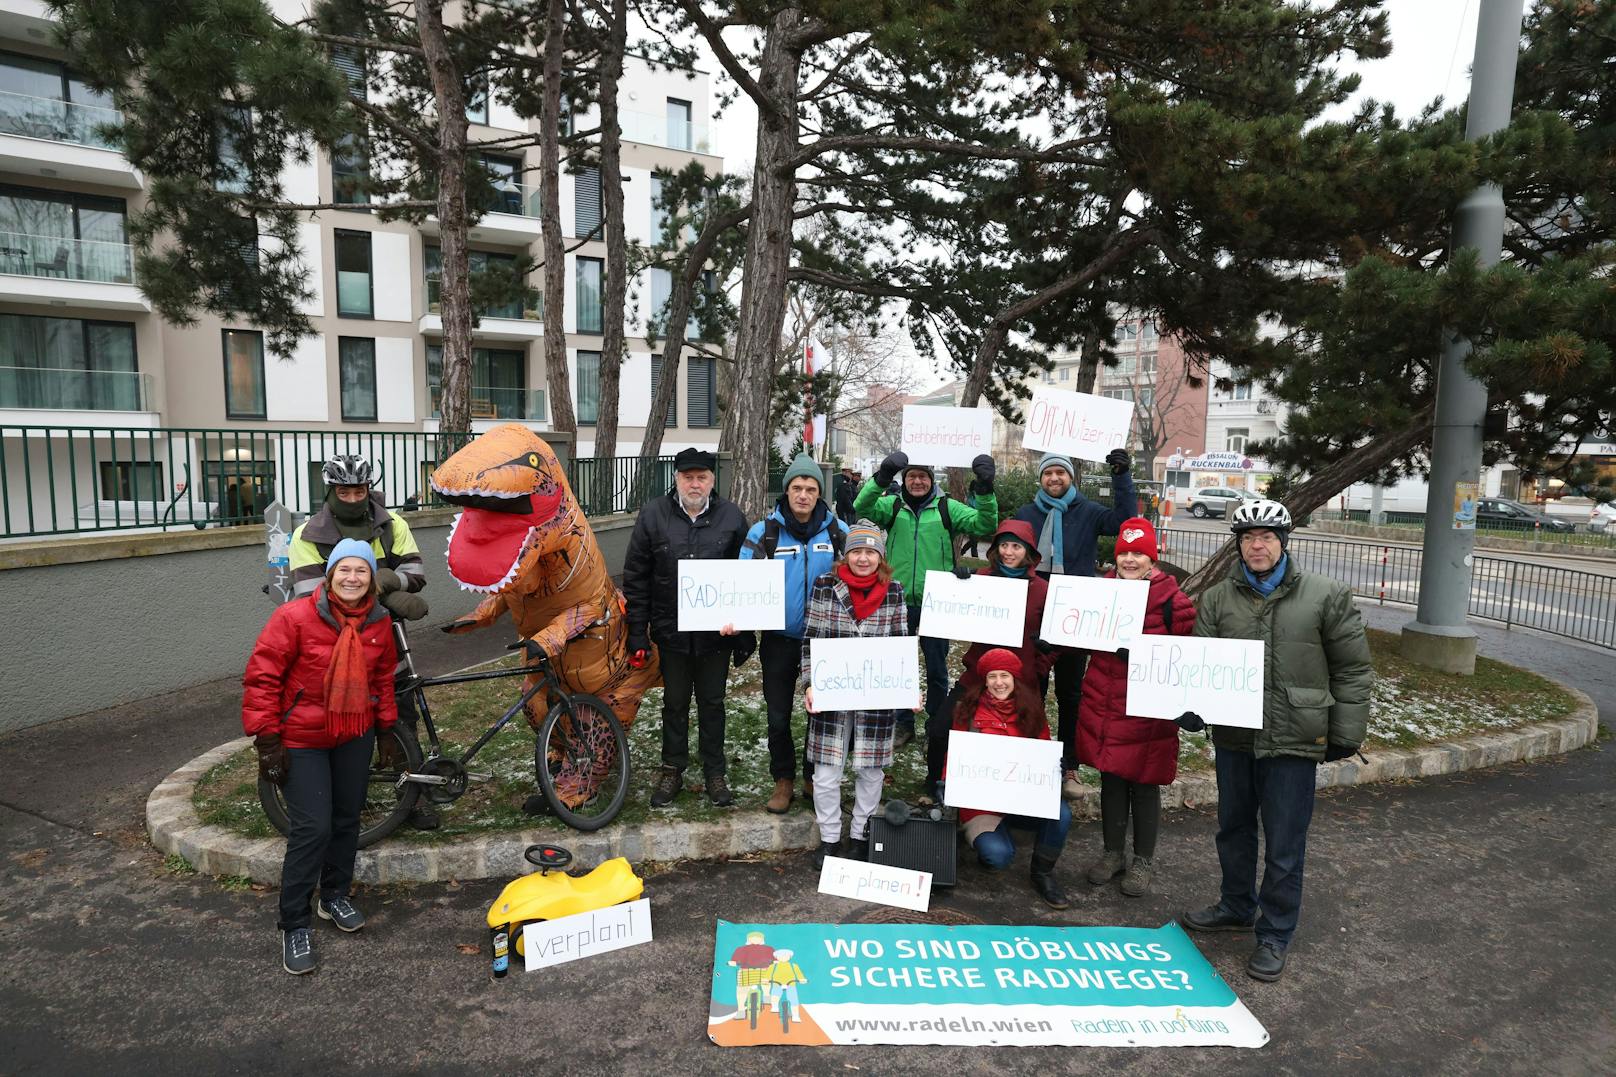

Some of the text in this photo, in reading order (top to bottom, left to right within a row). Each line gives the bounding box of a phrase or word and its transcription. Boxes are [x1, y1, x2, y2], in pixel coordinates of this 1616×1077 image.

[903, 423, 981, 448] Gehbehinderte
[1600, 445, 1616, 453] PA
[1190, 460, 1254, 469] RUCKENBAUR
[1048, 585, 1135, 642] Familie
[813, 656, 913, 697] Geschäftsleute
[535, 905, 633, 958] verplant
[823, 936, 1172, 962] WO SIND DÖBLINGS
[830, 966, 1194, 991] SICHERE RADWEGE?
[835, 1016, 1053, 1034] www.radeln.wien
[1070, 1018, 1133, 1034] Radeln
[1138, 1018, 1159, 1034] in
